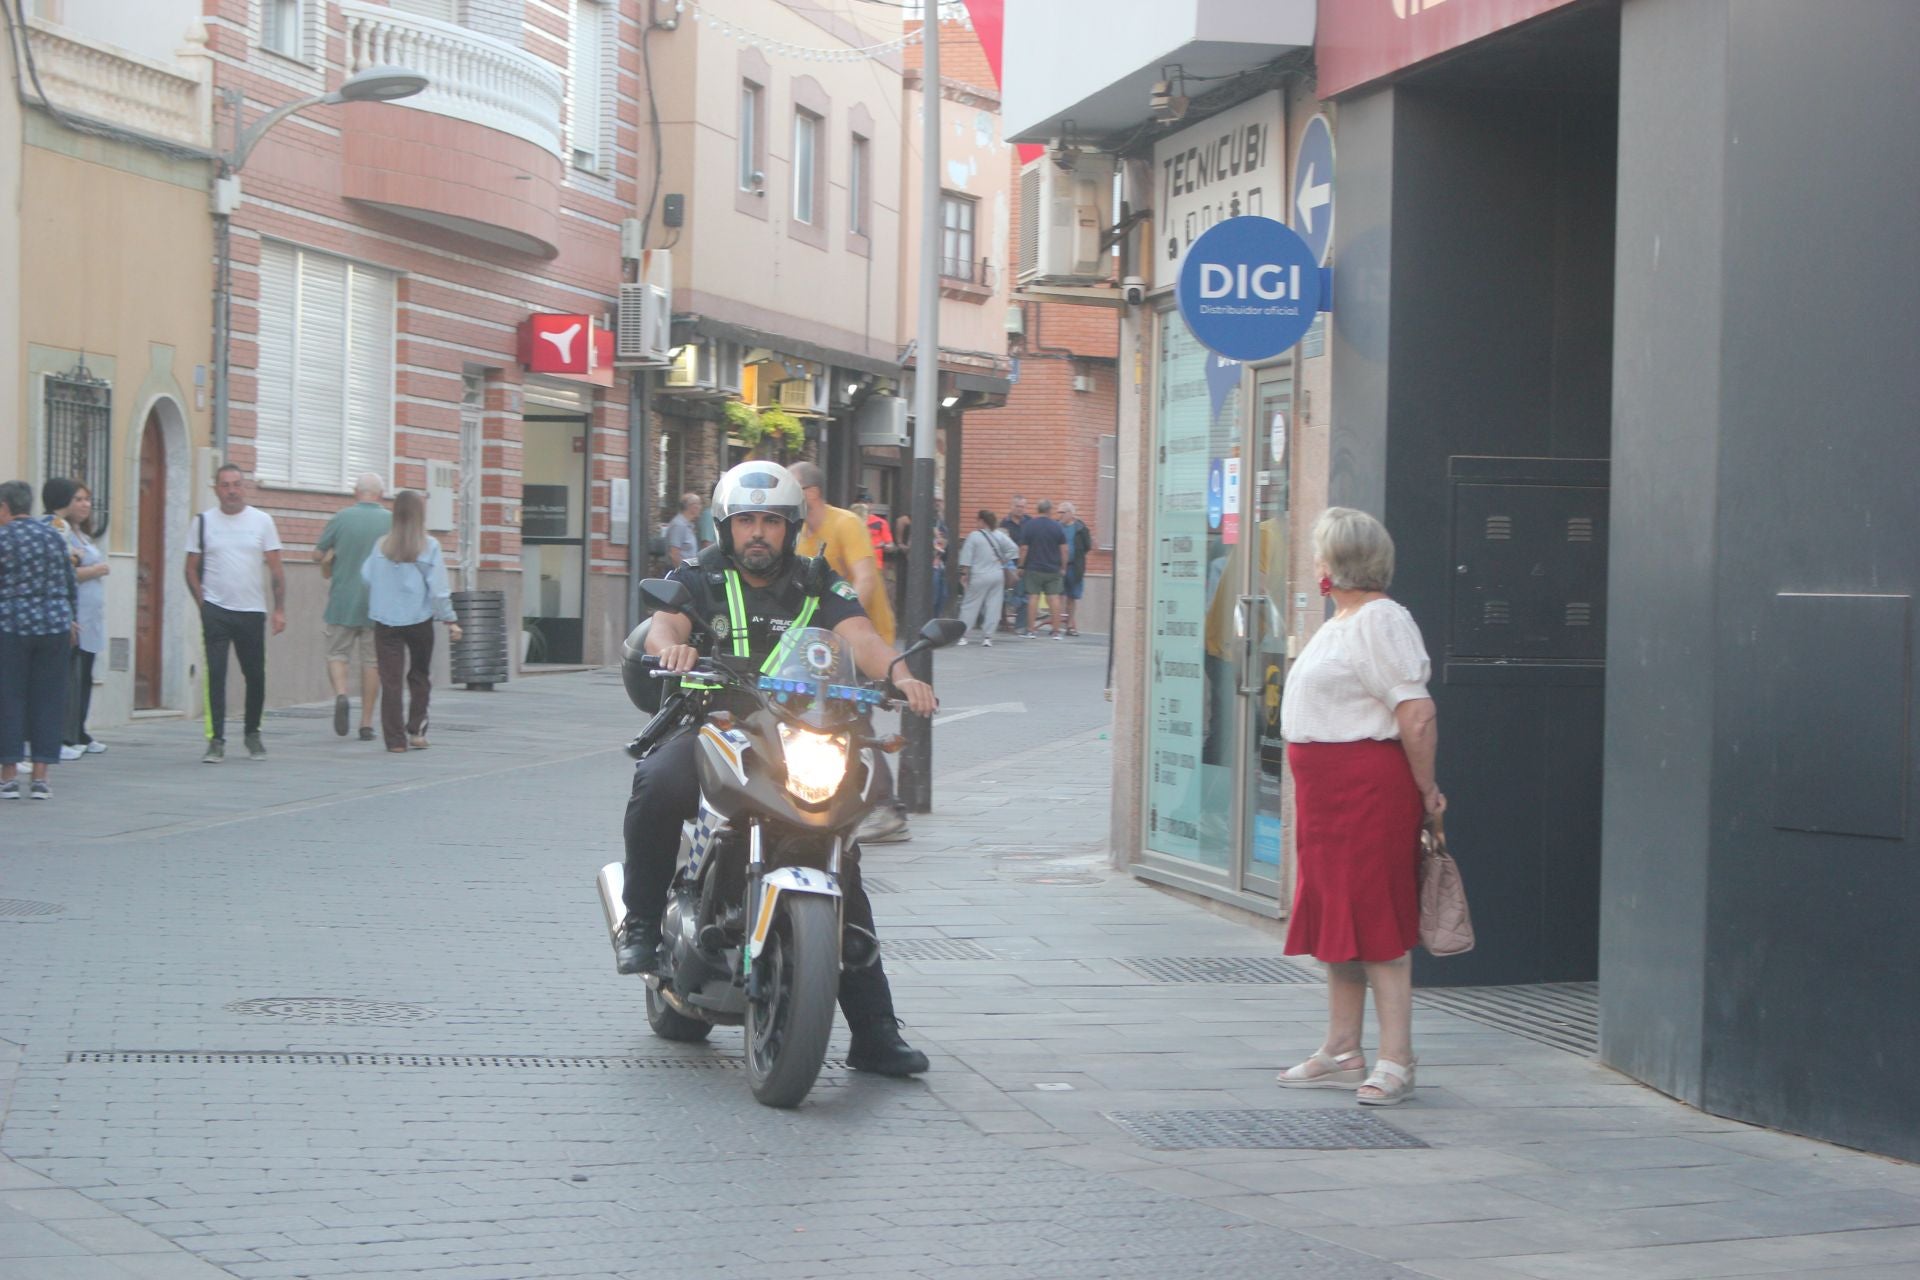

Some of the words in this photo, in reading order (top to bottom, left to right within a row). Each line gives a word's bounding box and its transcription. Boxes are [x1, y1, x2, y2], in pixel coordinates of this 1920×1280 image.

[1200, 263, 1300, 300] DIGI
[1200, 304, 1263, 315] Distribuidor
[1264, 306, 1299, 316] oficial
[770, 618, 793, 626] POLIC
